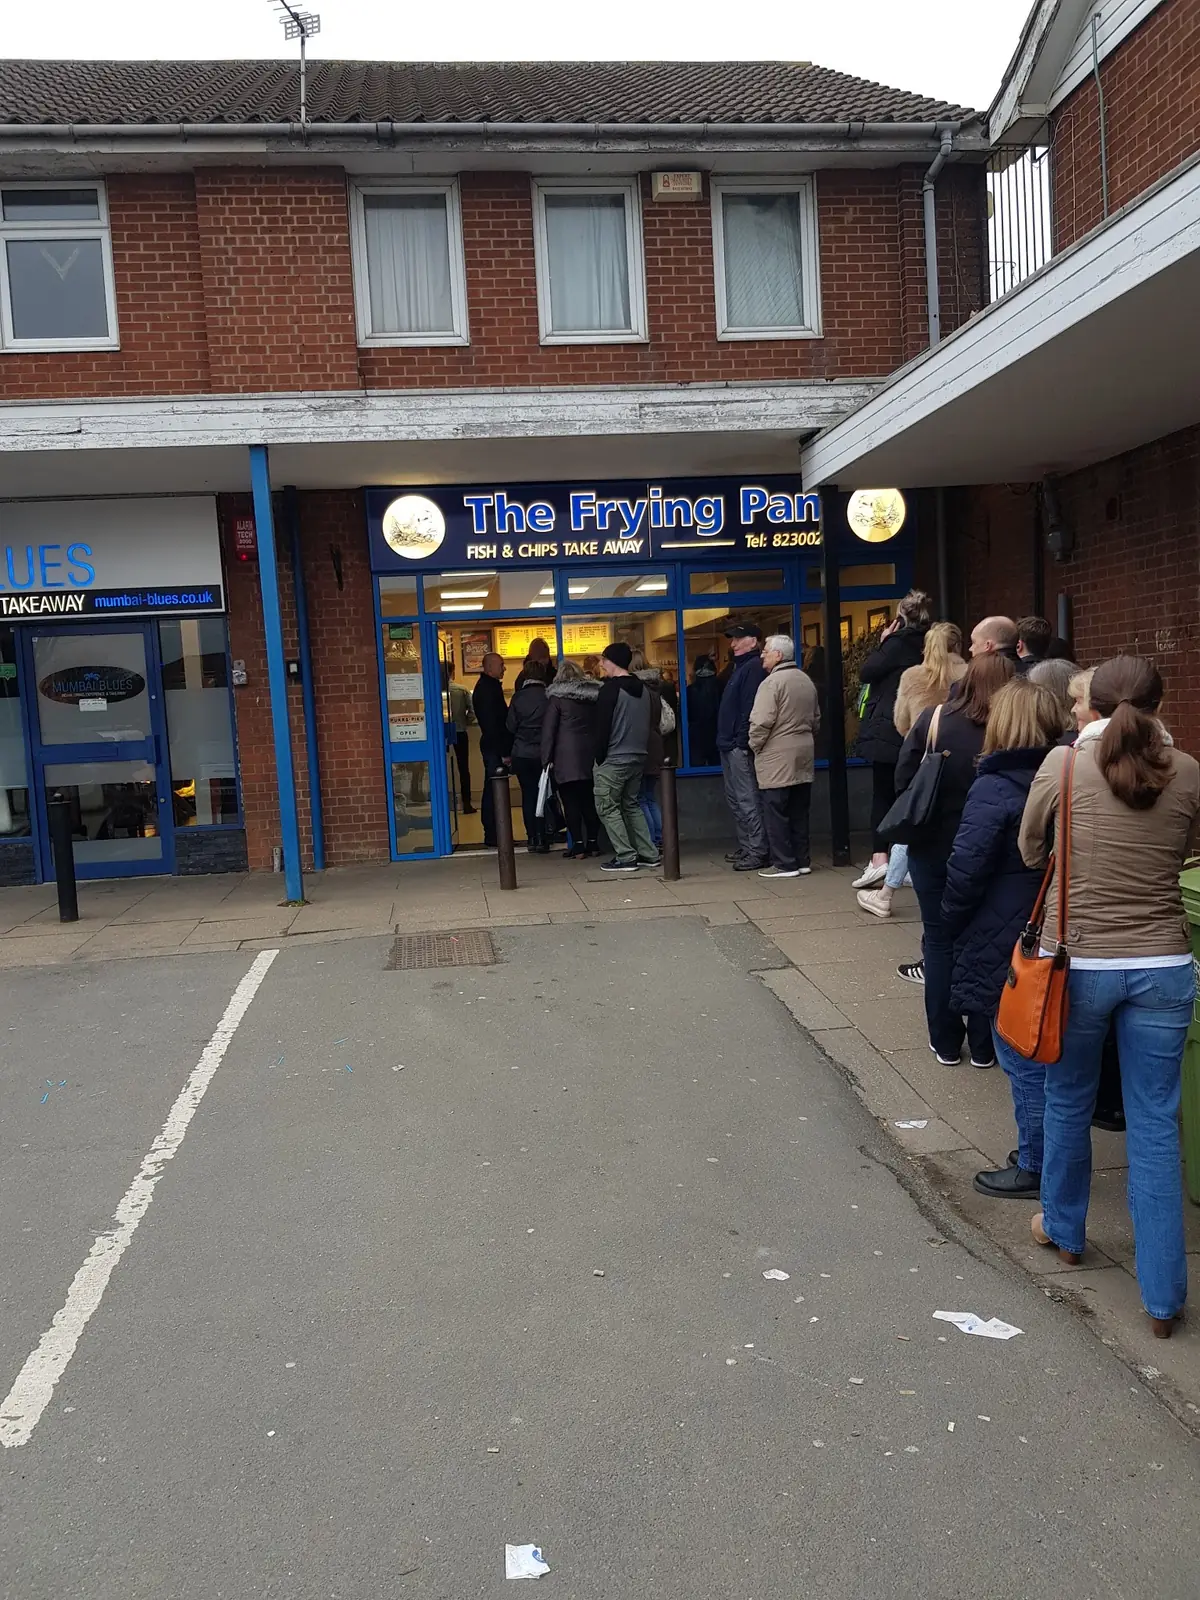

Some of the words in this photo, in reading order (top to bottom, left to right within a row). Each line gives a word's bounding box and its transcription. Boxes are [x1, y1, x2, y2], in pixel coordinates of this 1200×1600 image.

[464, 492, 555, 534] The
[570, 488, 725, 540] Frying
[740, 486, 820, 525] Pan
[745, 534, 767, 548] Tel:
[772, 531, 821, 547] 823002
[467, 545, 497, 559] FISH
[502, 545, 514, 558] &
[518, 543, 558, 557] CHIPS
[563, 541, 598, 556] TAKE
[603, 540, 644, 555] AWAY
[0, 543, 95, 590] UES
[0, 594, 85, 615] TAKEAWAY
[95, 591, 213, 608] mumbai-blues.co.uk
[53, 681, 96, 693] MUMBAI
[99, 679, 133, 691] BLUES
